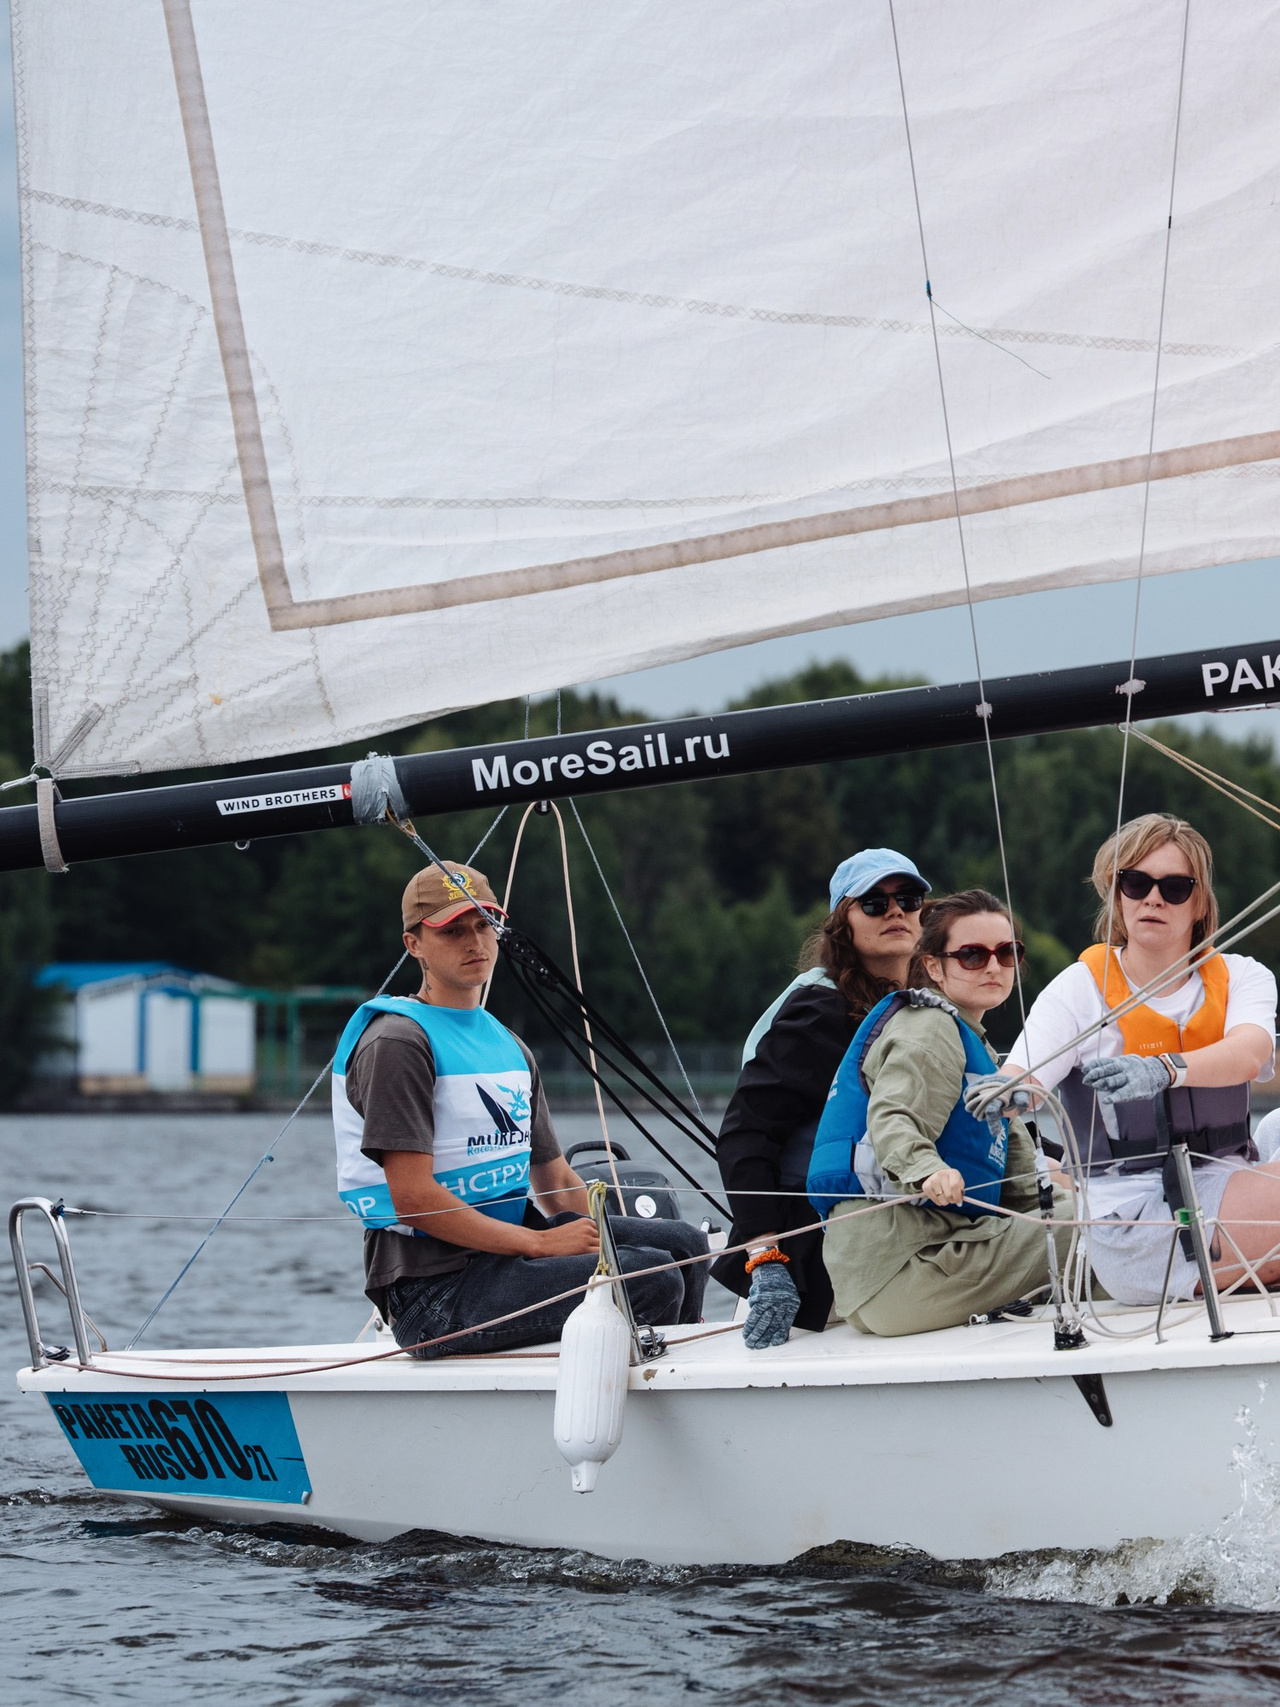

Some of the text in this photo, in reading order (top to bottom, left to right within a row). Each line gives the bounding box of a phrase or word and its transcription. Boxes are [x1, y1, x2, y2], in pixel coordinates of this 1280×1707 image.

[471, 733, 731, 791] MoreSail.ru
[223, 788, 336, 812] WIND BROTHERS
[119, 1444, 278, 1481] RUS 27
[148, 1398, 253, 1481] 670
